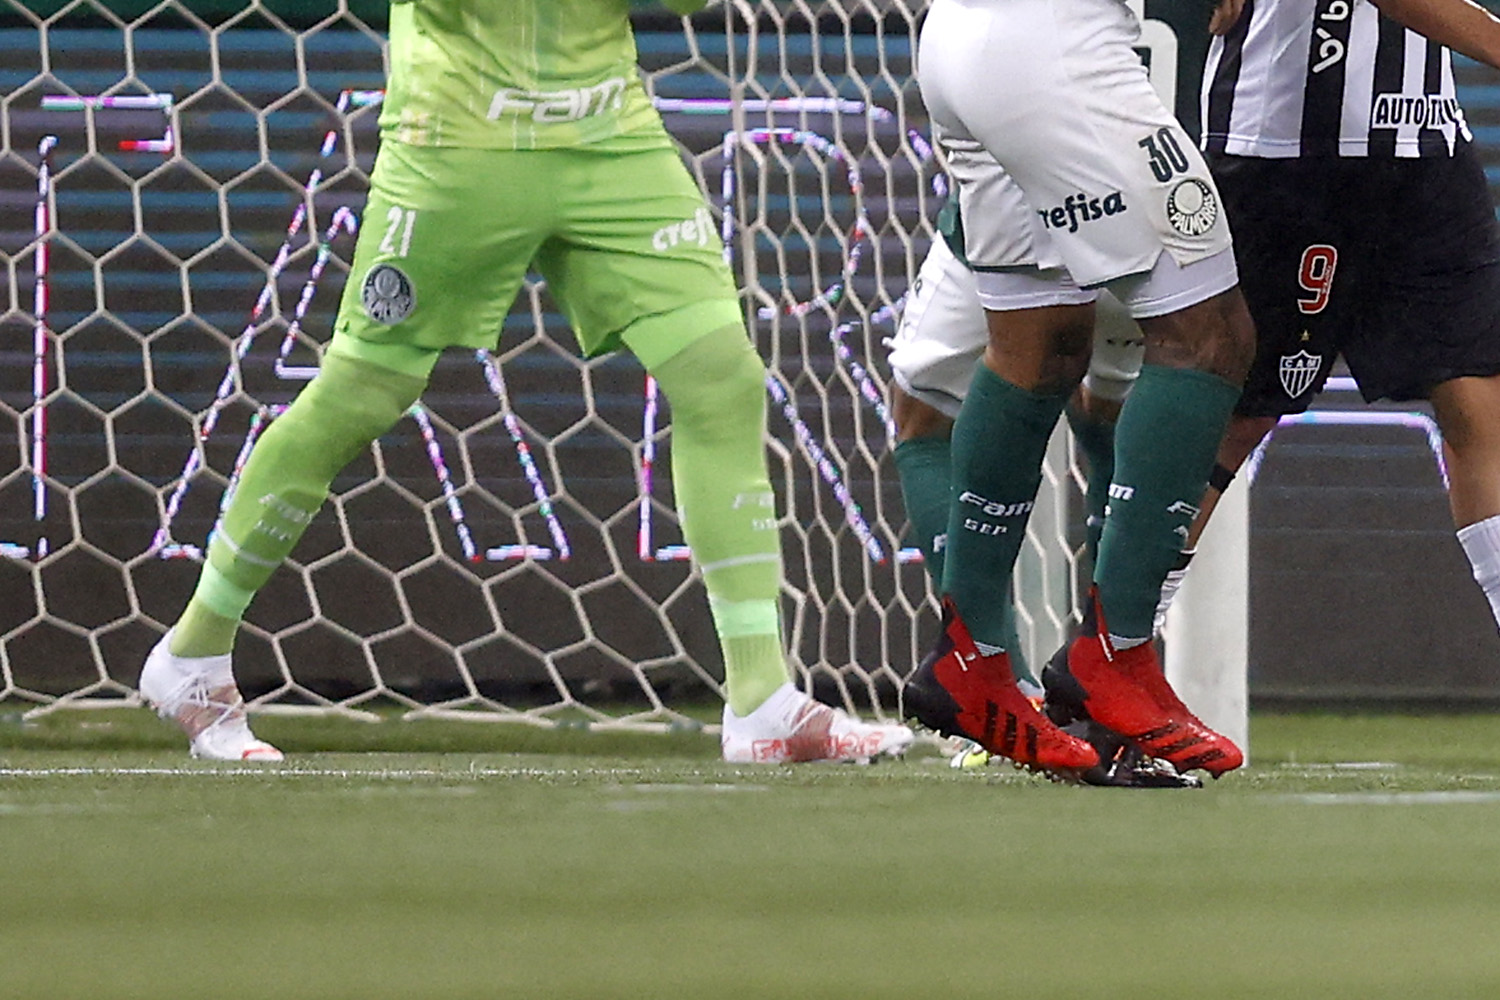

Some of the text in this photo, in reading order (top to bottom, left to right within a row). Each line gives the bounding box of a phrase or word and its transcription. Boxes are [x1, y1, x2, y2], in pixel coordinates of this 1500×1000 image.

[486, 76, 628, 123] Fam
[1138, 127, 1190, 183] 30
[379, 205, 417, 257] 21
[1037, 191, 1128, 234] refisa
[1297, 244, 1338, 315] 9
[963, 517, 1009, 536] SEP
